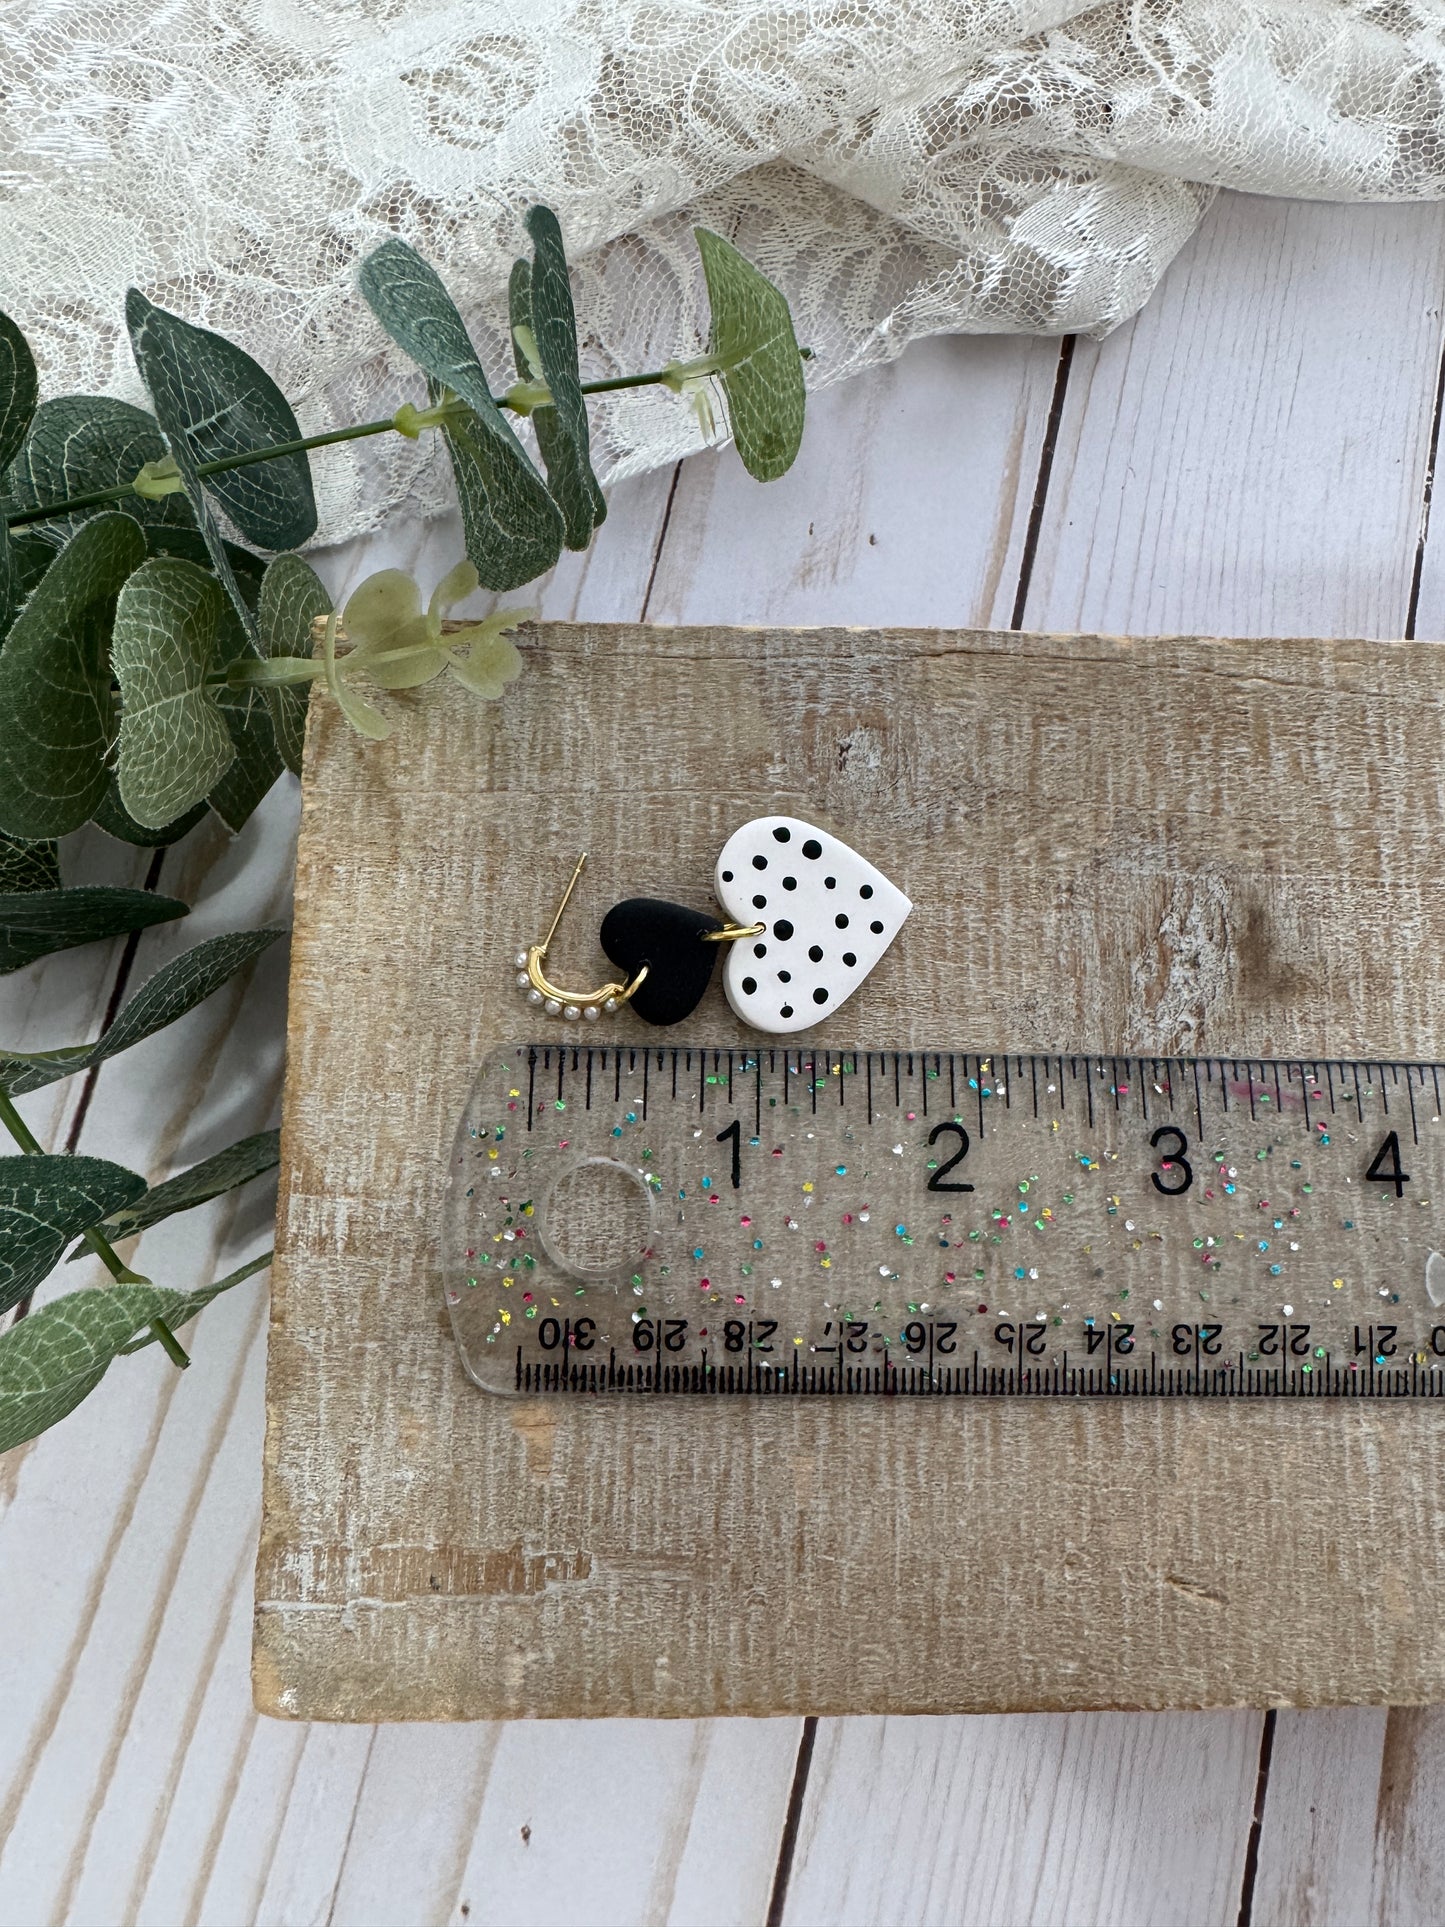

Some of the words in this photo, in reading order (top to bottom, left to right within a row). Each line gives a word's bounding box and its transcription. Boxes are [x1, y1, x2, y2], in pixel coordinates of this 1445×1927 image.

[716, 1120, 740, 1189] 1
[928, 1122, 975, 1192] 2
[1150, 1126, 1193, 1196] 3
[1366, 1130, 1410, 1198] 4
[538, 1317, 596, 1350] 30
[632, 1319, 688, 1351] 29
[724, 1320, 778, 1352] 28
[905, 1322, 957, 1353] 26
[994, 1323, 1046, 1354] 25
[1083, 1324, 1135, 1354] 24
[1171, 1324, 1222, 1355] 23
[1258, 1325, 1310, 1355] 22
[1354, 1325, 1397, 1357] 21
